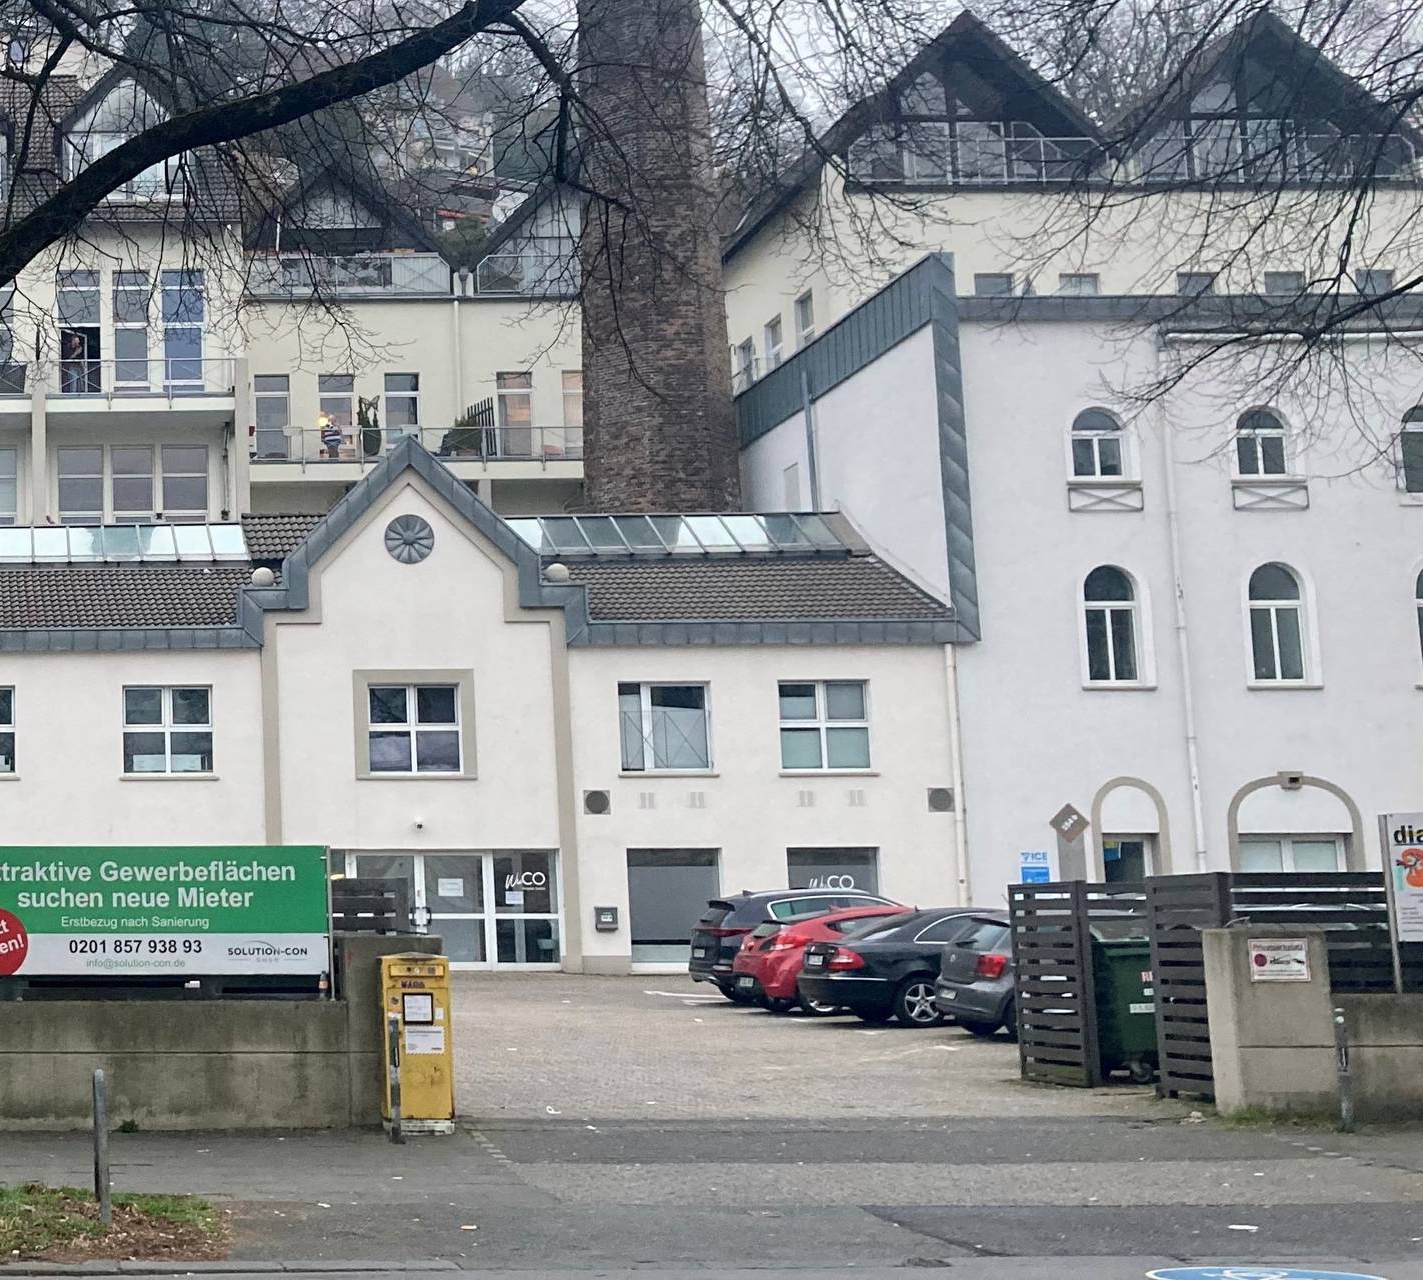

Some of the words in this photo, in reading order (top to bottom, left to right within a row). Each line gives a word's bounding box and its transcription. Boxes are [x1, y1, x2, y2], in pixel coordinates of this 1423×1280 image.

[99, 860, 296, 881] Gewerbeflächen
[17, 887, 103, 907] suchen
[112, 891, 170, 907] neue
[177, 887, 254, 907] Mieter
[61, 916, 118, 929] Erstbezug
[121, 916, 148, 928] nach
[151, 916, 210, 929] Sanierung
[69, 939, 106, 954] 0201
[113, 939, 143, 954] 857
[148, 939, 177, 954] 938
[182, 939, 202, 954] 93
[227, 947, 308, 956] SOLUTION-CON
[86, 958, 186, 969] info@solution-con.de
